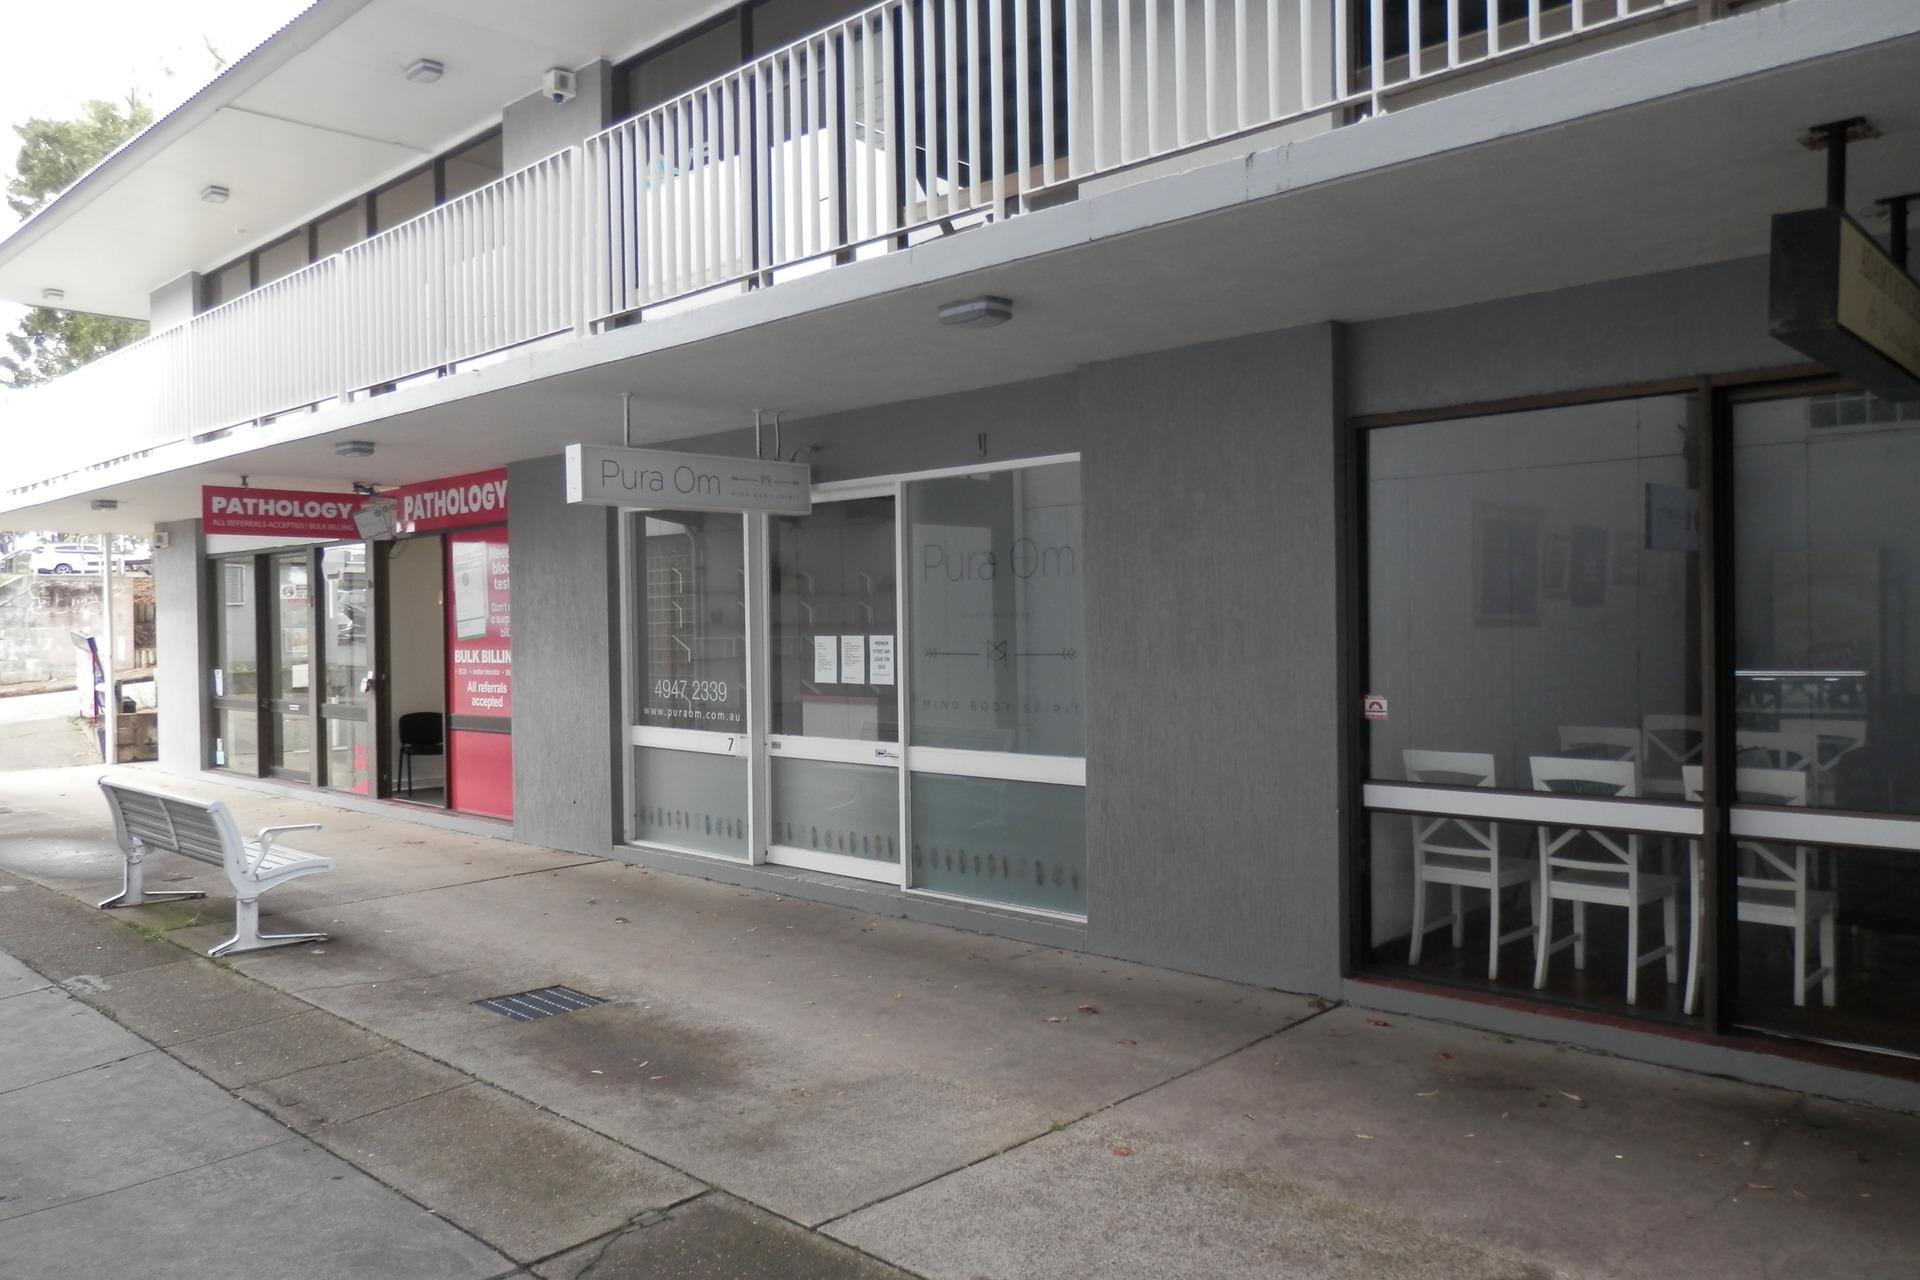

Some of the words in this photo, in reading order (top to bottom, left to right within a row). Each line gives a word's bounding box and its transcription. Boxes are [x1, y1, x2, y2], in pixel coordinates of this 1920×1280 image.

[602, 459, 664, 493] Pura
[673, 465, 721, 495] Om
[211, 496, 353, 519] PATHOLOGY
[403, 479, 508, 522] PATHOLOGY
[213, 519, 225, 527] ALL
[268, 522, 305, 530] ACCEPTED
[309, 523, 327, 531] BULK
[923, 543, 996, 582] Pura
[1010, 536, 1075, 580] Om
[454, 649, 480, 663] BULK
[467, 681, 477, 693] All
[478, 681, 508, 694] referrals
[654, 679, 687, 699] 4947
[691, 680, 728, 702] 2339
[471, 696, 504, 710] accepted
[643, 707, 741, 722] www.puraom.com.au
[727, 737, 735, 752] 7
